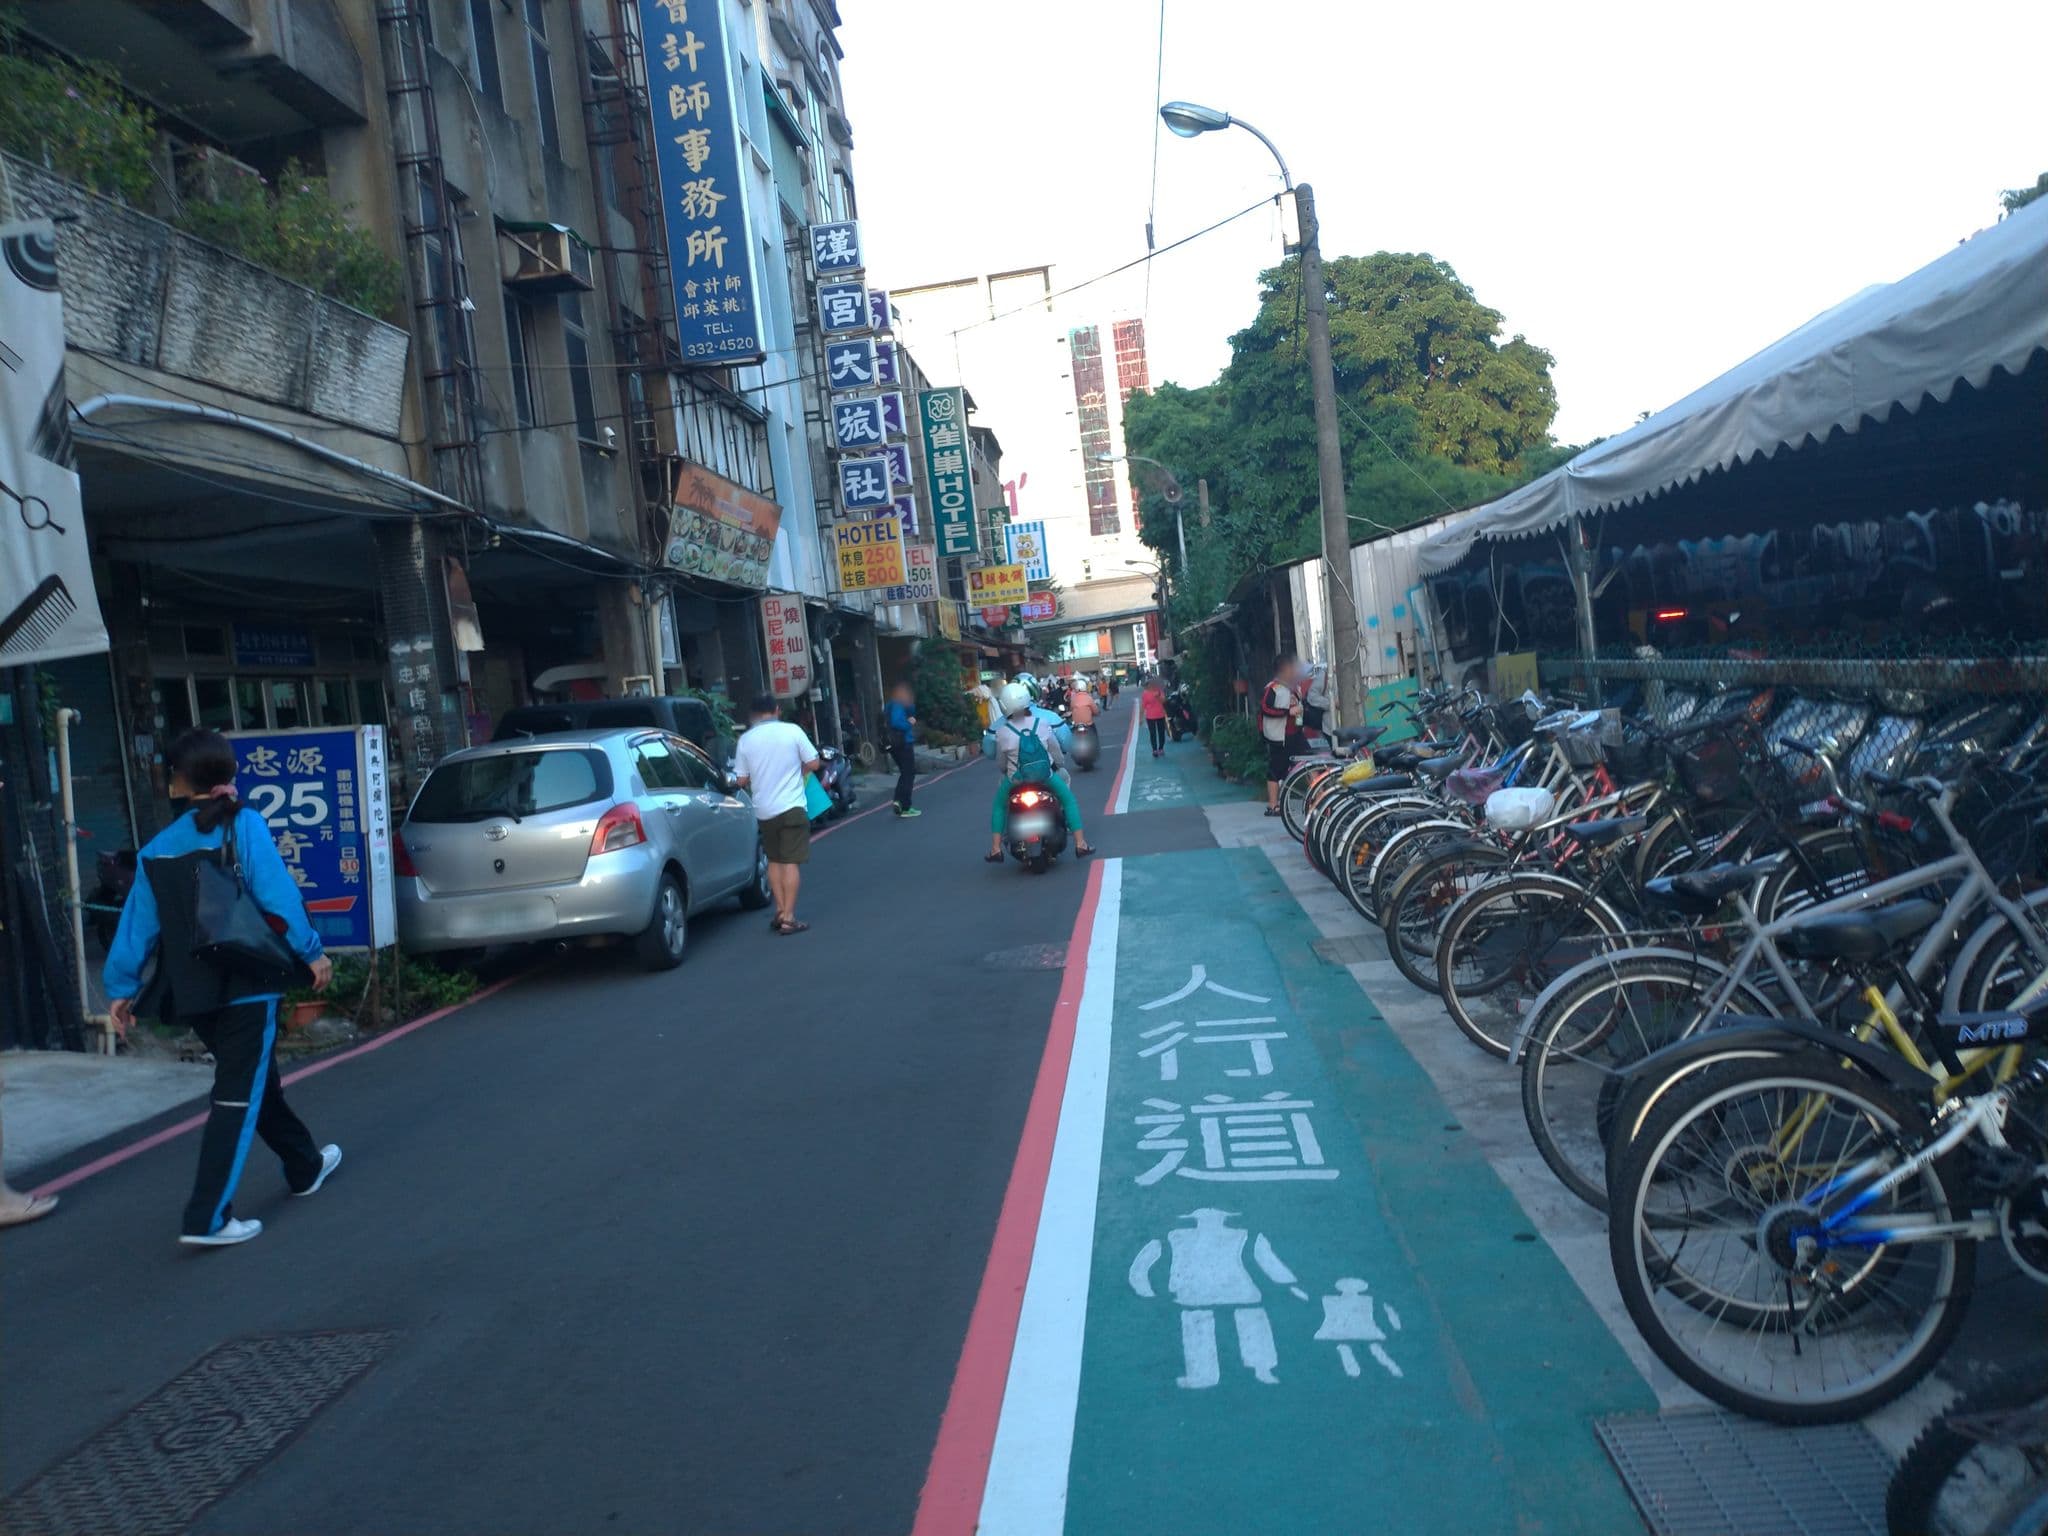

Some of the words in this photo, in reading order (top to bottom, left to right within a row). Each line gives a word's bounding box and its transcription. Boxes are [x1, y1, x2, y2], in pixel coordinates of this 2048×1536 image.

[655, 0, 728, 268] 會計師事務所
[683, 274, 741, 299] 會計師
[815, 228, 886, 500] 漢宮大旅社
[838, 522, 897, 545] HOTEL
[842, 551, 864, 567] 休息
[865, 545, 896, 565] 250
[843, 570, 866, 587] 住宿
[867, 565, 898, 585] 500
[784, 607, 807, 680] 燒仙草
[242, 745, 327, 777] 忠源
[248, 781, 329, 827] 25
[320, 825, 333, 841] 元
[1134, 964, 1341, 1187] 人行道
